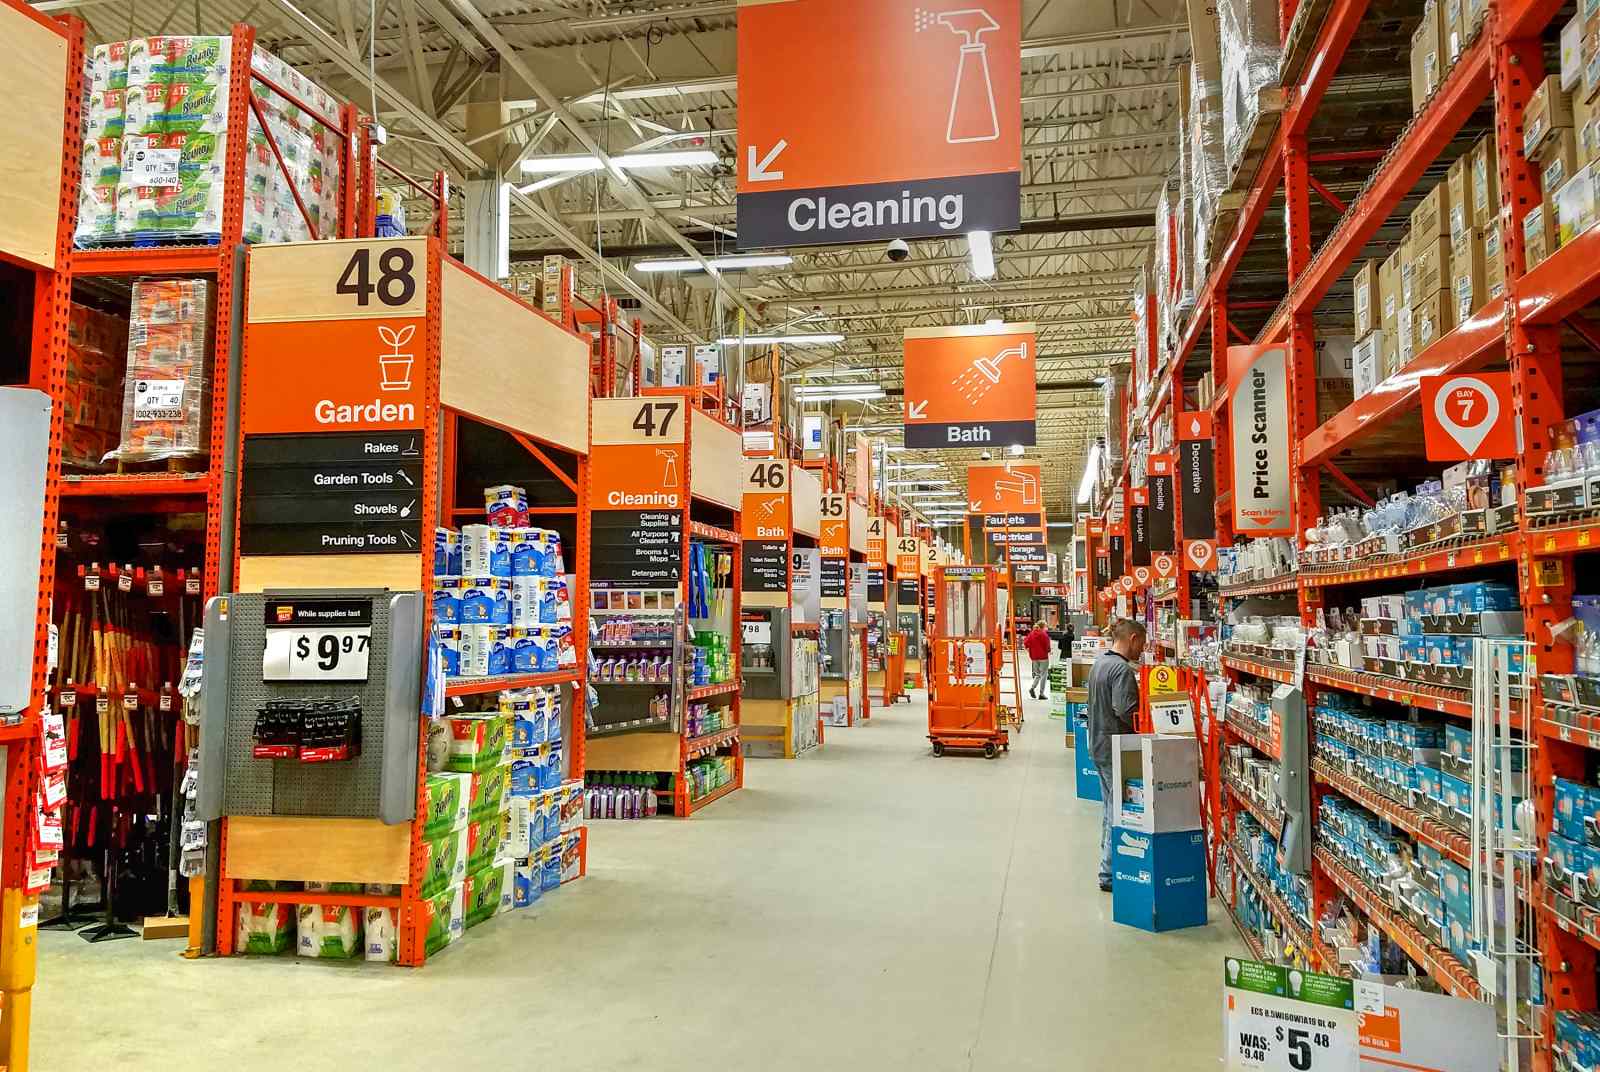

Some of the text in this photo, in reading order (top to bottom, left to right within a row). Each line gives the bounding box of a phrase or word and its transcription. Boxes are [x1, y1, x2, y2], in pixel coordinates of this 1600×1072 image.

[787, 190, 964, 232] Cleaning
[336, 247, 415, 306] 48
[147, 397, 159, 405] QTY
[1456, 390, 1474, 398] BAY
[314, 399, 415, 424] Garden
[1457, 399, 1474, 421] 7
[632, 402, 679, 437] 47
[947, 427, 991, 442] Bath
[1251, 368, 1269, 500] Price Scanner
[364, 442, 399, 455] Rakes
[750, 463, 785, 488] 46
[1192, 443, 1201, 494] Decorative
[313, 472, 394, 486] Garden Tools
[608, 491, 678, 508] Cleaning
[1157, 478, 1166, 511] Specialty
[353, 503, 398, 516] Shovels
[820, 497, 842, 516] 45
[1240, 509, 1262, 517] Scan
[640, 512, 669, 524] Cleaning
[640, 520, 668, 531] Supplies
[631, 531, 669, 542] All Purpose
[757, 527, 785, 537] Bath
[321, 535, 397, 548] Pruning Tools
[639, 537, 669, 545] Cleaners
[898, 540, 916, 552] 43
[636, 549, 662, 557] Brooms
[650, 555, 669, 564] Mops
[631, 570, 668, 579] Detergents
[297, 609, 317, 618] While
[318, 610, 347, 619] supplies
[348, 610, 361, 618] last
[297, 634, 371, 671] $ 9 97
[1170, 709, 1179, 725] 6
[1251, 1006, 1264, 1016] ECS
[1327, 1021, 1337, 1030] 4P
[1240, 1032, 1270, 1052] WAS:
[1275, 1026, 1330, 1071] $ 5 48
[1240, 1046, 1265, 1062] $9.48
